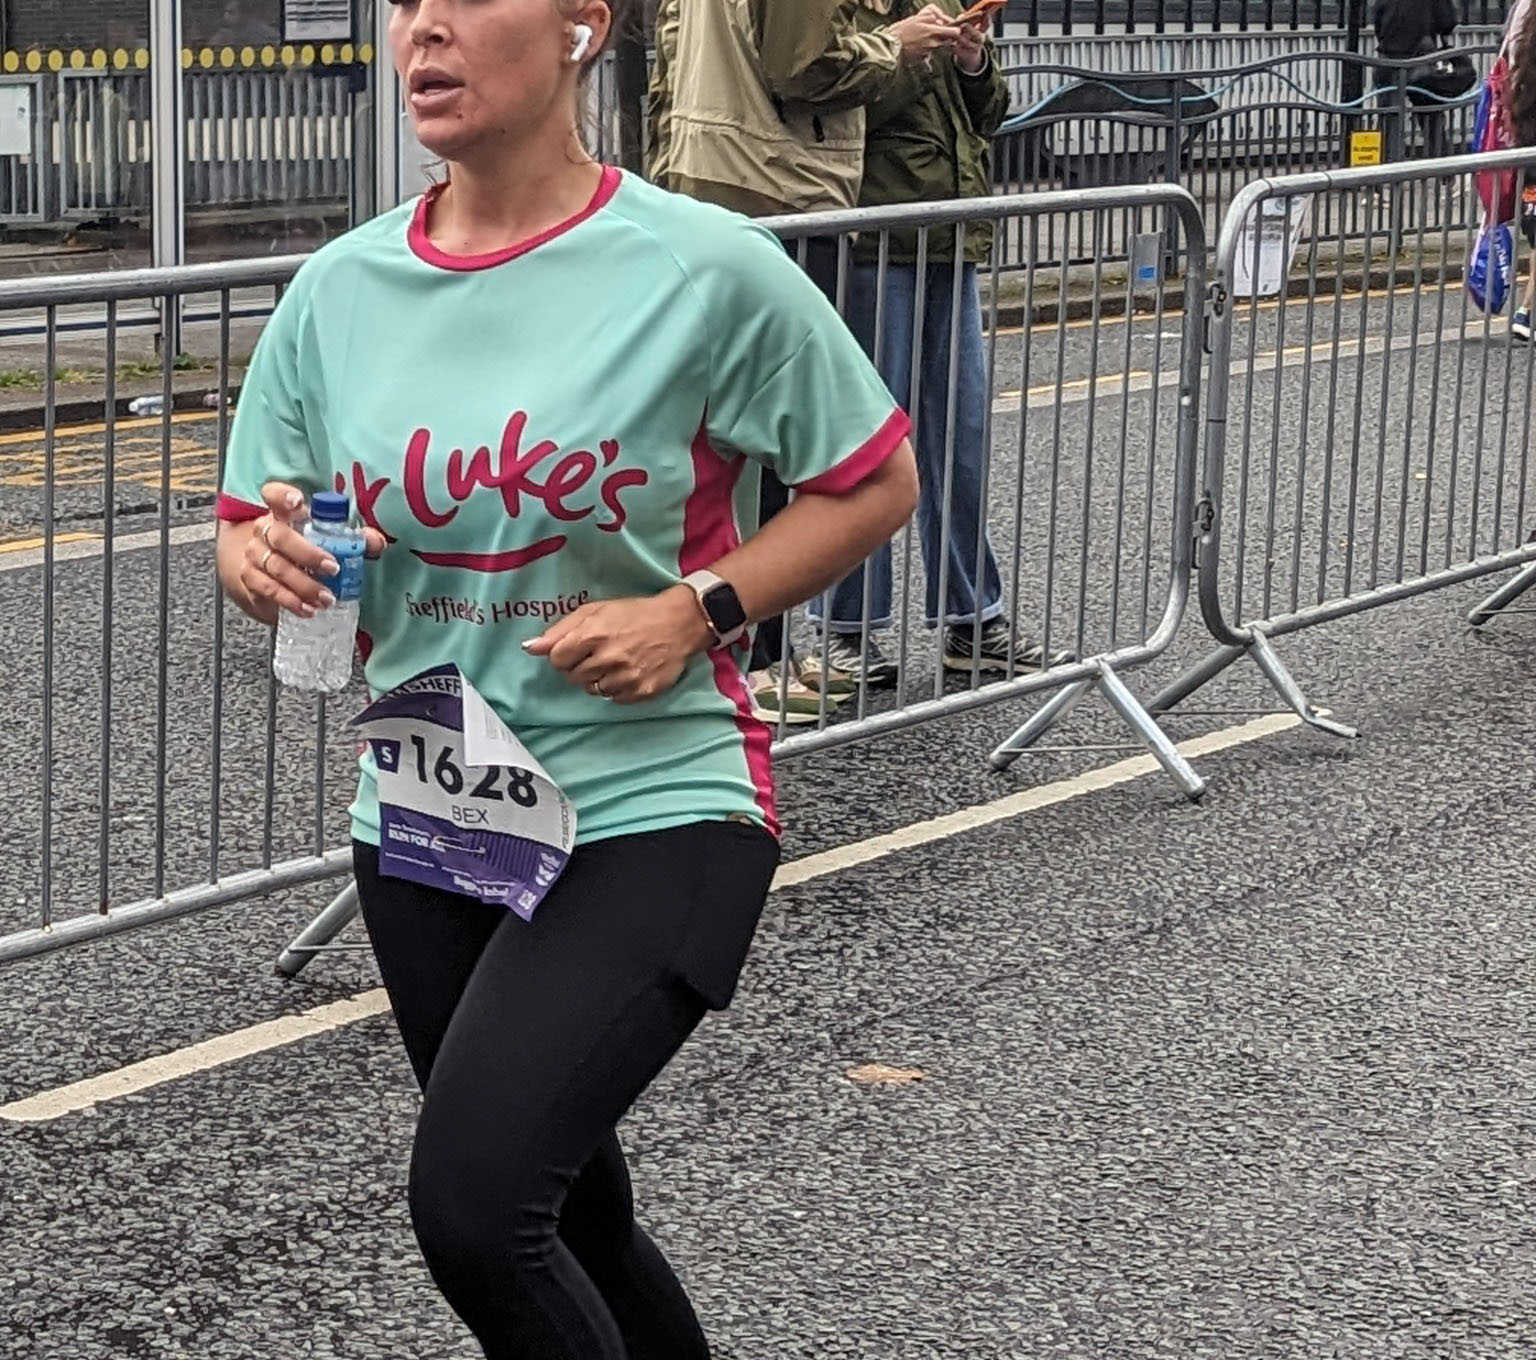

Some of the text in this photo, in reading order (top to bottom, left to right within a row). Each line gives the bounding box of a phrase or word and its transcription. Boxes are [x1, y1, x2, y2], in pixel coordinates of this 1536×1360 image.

[404, 410, 648, 533] Luke's
[491, 590, 588, 623] Hospice
[381, 745, 393, 764] S
[410, 734, 538, 808] 1628
[451, 804, 490, 825] BEX
